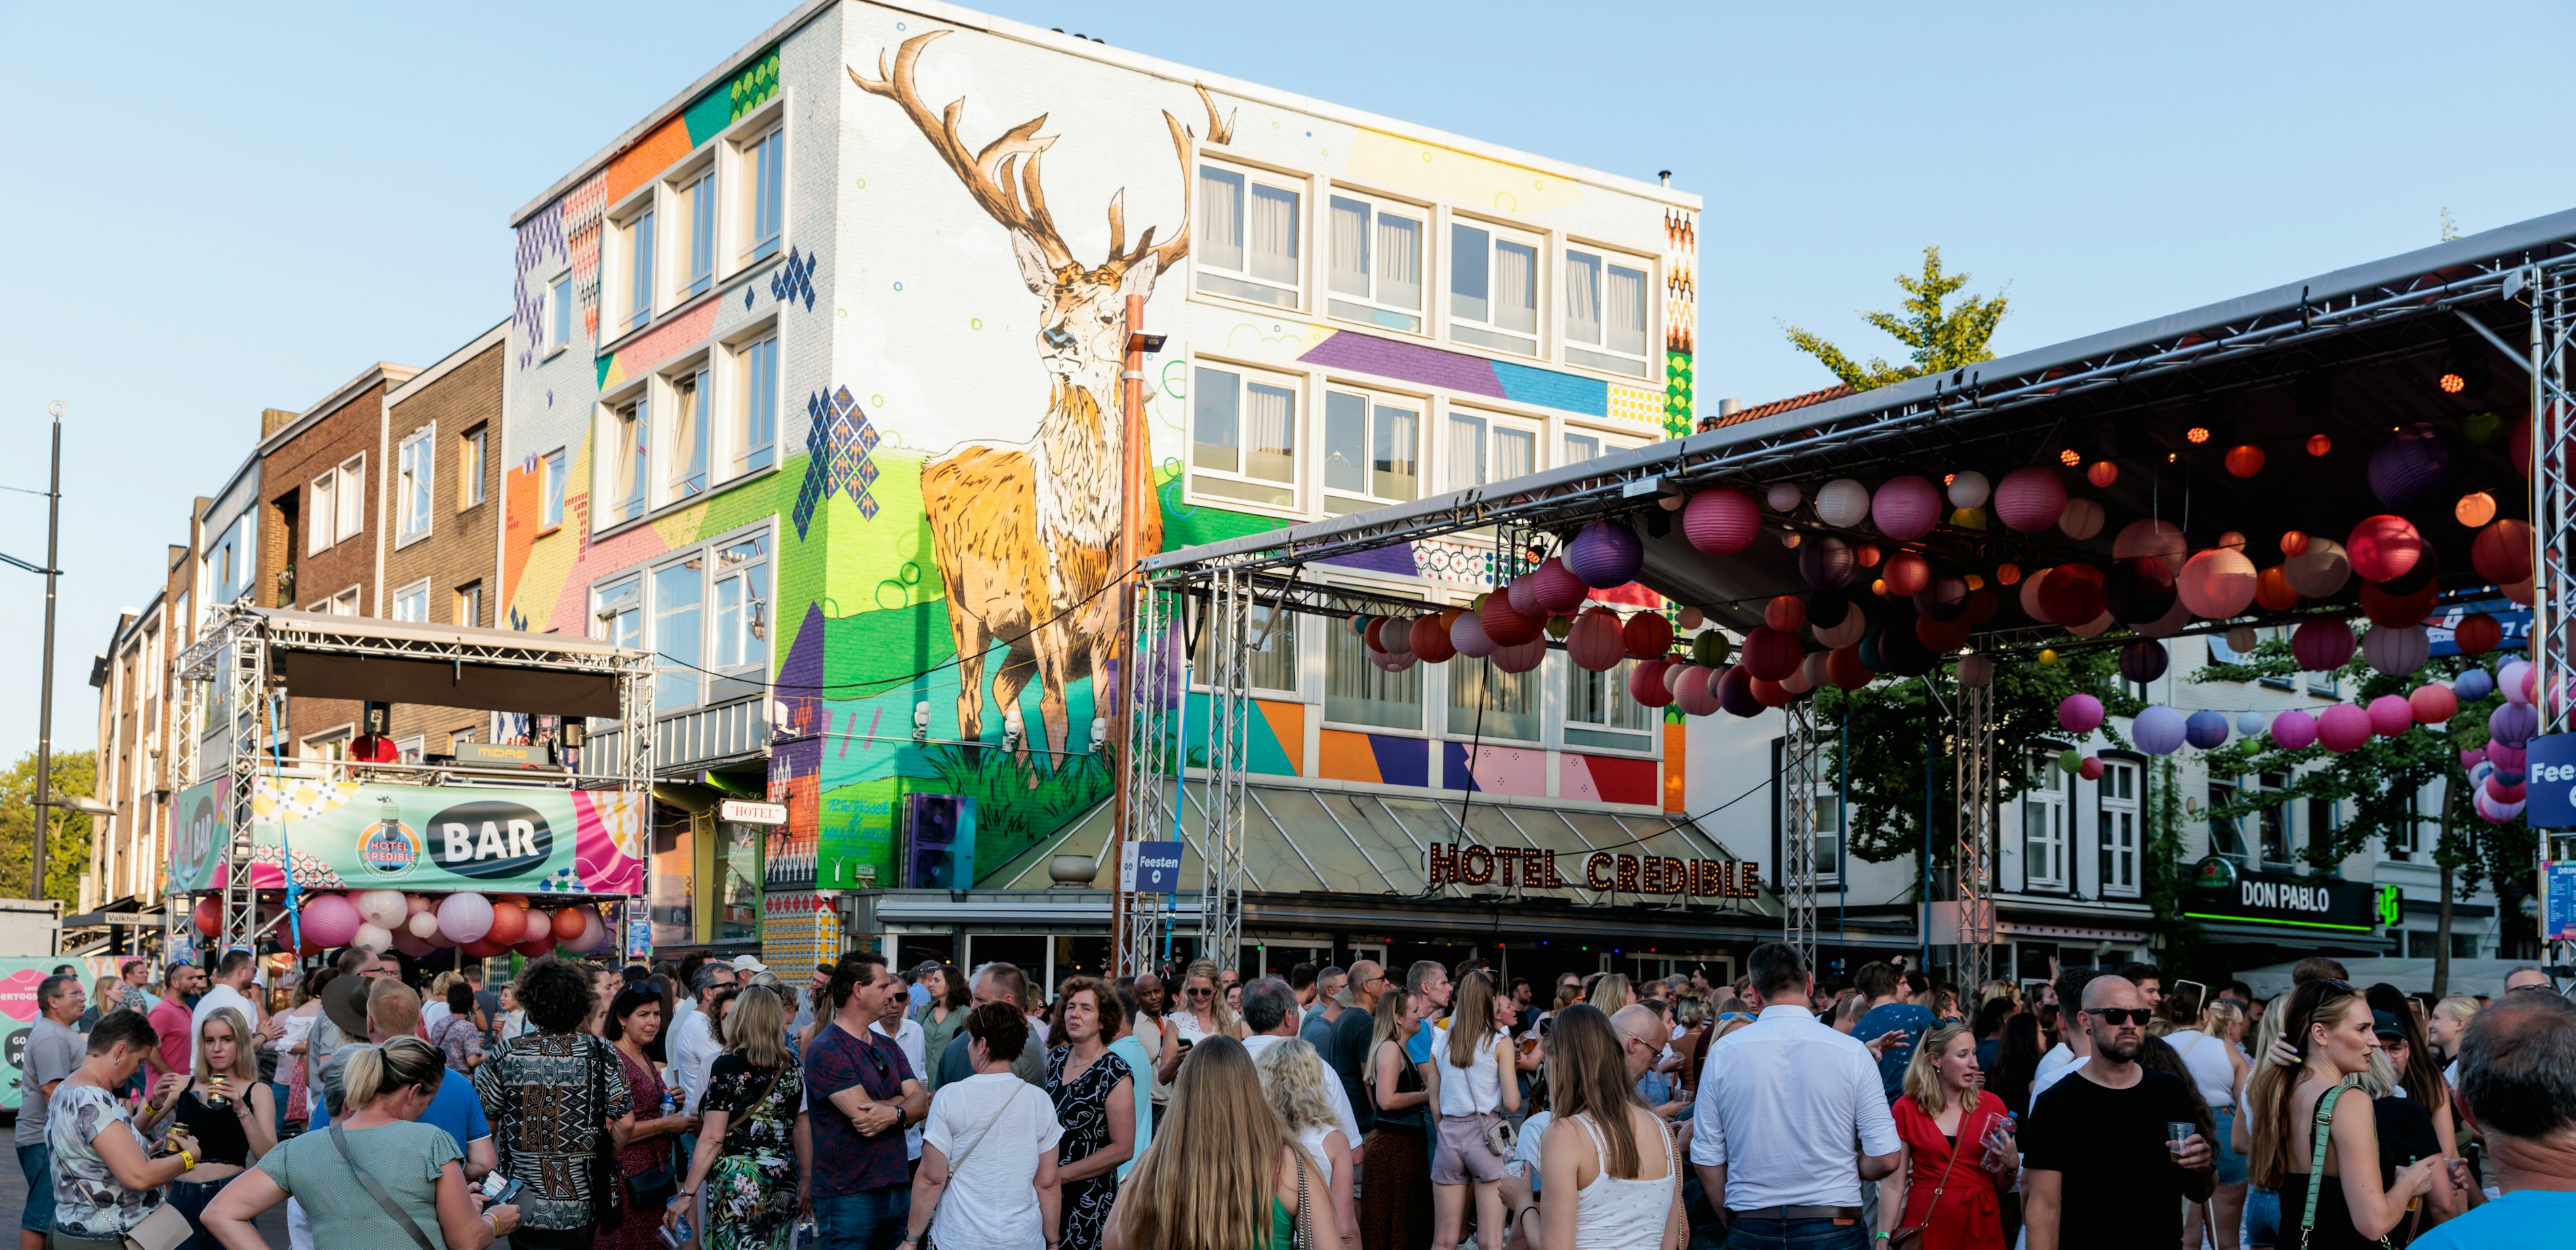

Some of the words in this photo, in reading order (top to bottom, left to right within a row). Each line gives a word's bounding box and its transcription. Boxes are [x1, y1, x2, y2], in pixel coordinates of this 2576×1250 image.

[478, 748, 527, 759] MIDAS
[2531, 763, 2576, 784] Fee
[193, 813, 212, 860] BAR
[443, 819, 540, 862] BAR
[371, 841, 408, 851] HOTEL
[363, 851, 417, 862] CREDIBLE
[1140, 855, 1178, 868] Feesten
[1426, 842, 1562, 889] HOTEL
[1583, 851, 1759, 899] CREDIBLE
[2242, 881, 2277, 908] DON
[2280, 884, 2329, 912] PABLO
[108, 914, 140, 923] Valkhof
